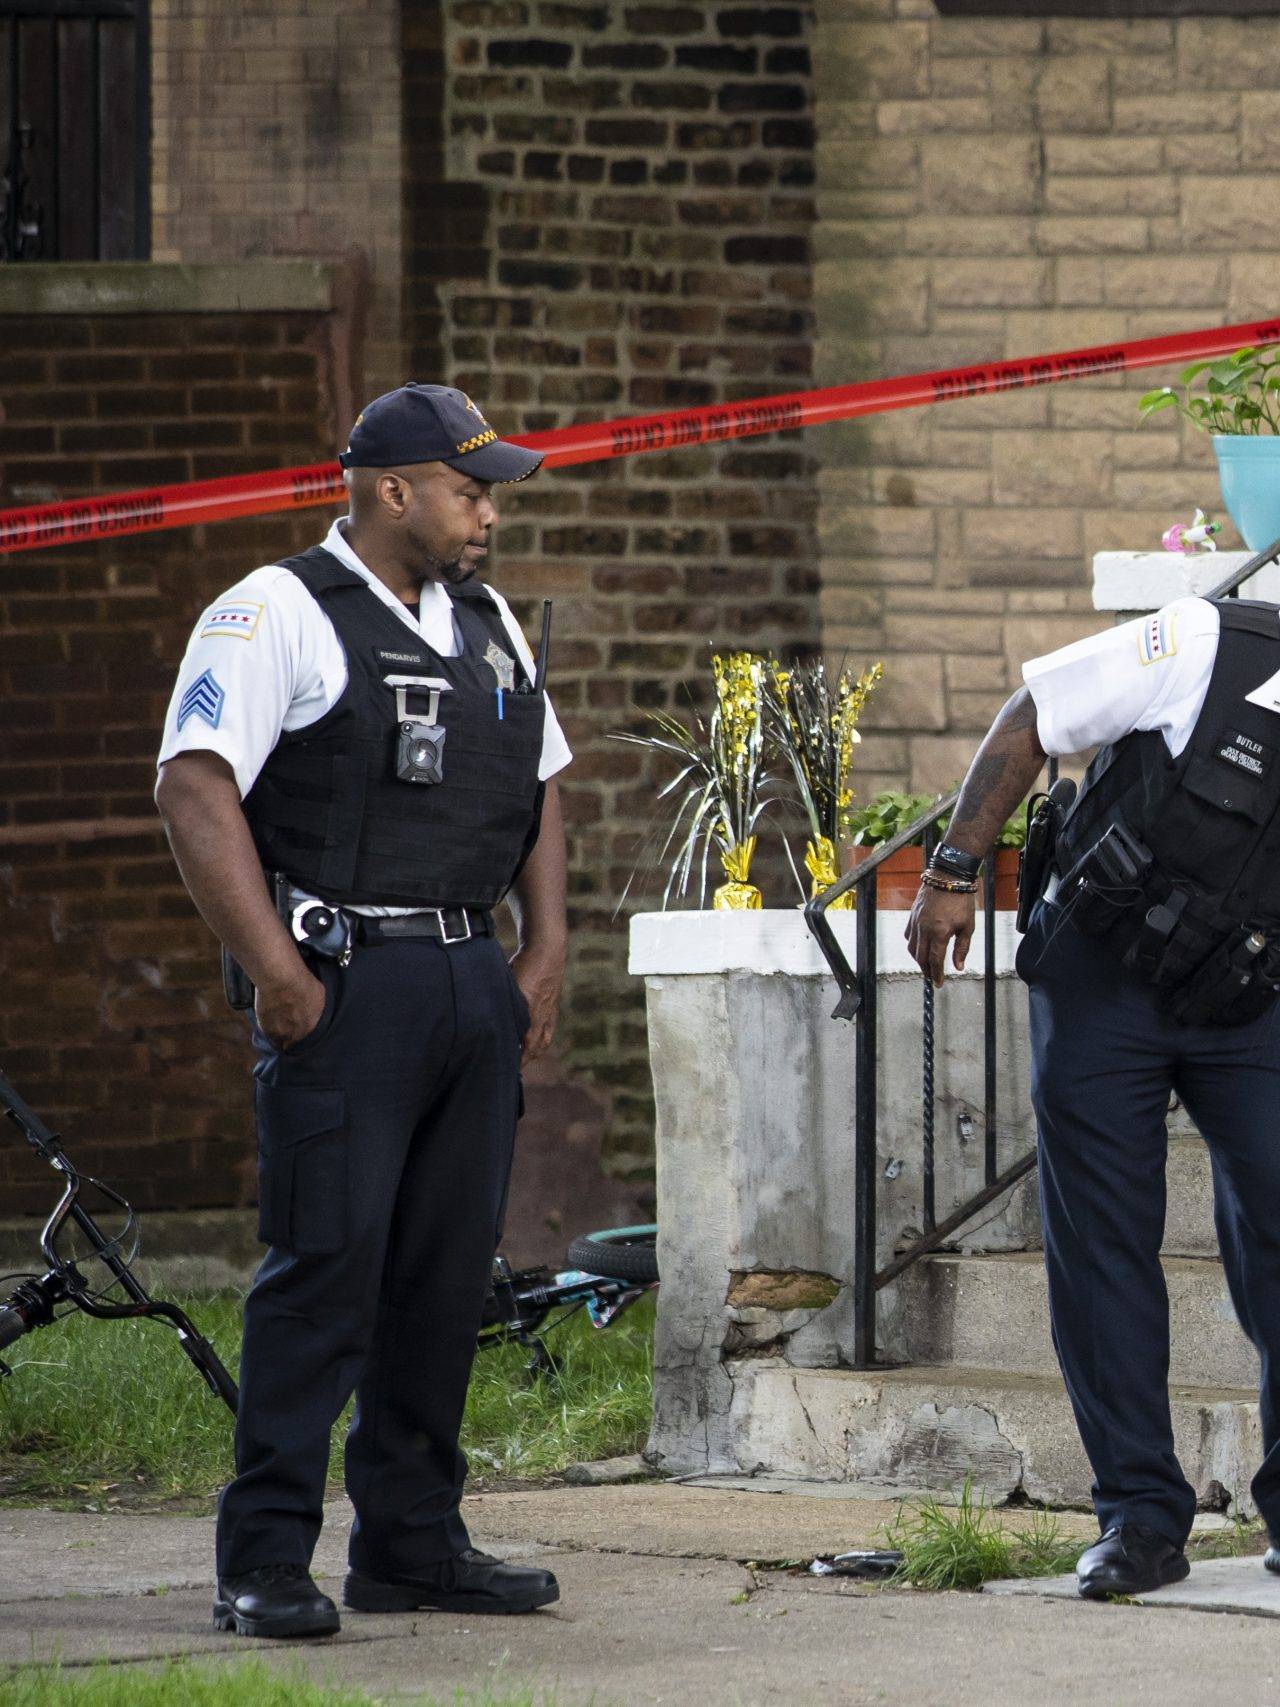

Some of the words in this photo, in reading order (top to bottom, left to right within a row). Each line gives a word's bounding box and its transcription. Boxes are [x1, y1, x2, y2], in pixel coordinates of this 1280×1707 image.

[993, 367, 1025, 392] NOT
[1028, 360, 1052, 387] DO
[1056, 350, 1125, 381] DANGER
[932, 371, 987, 401] ENTER
[671, 416, 701, 445] NOT
[707, 412, 730, 440] DO
[734, 401, 802, 435] DANGER
[610, 422, 665, 454] ENTER
[34, 511, 65, 543] NOT
[70, 506, 92, 536] DO
[96, 495, 164, 532] DANGER
[380, 651, 421, 663] PENDARVIS
[1236, 735, 1262, 754] BUTLER
